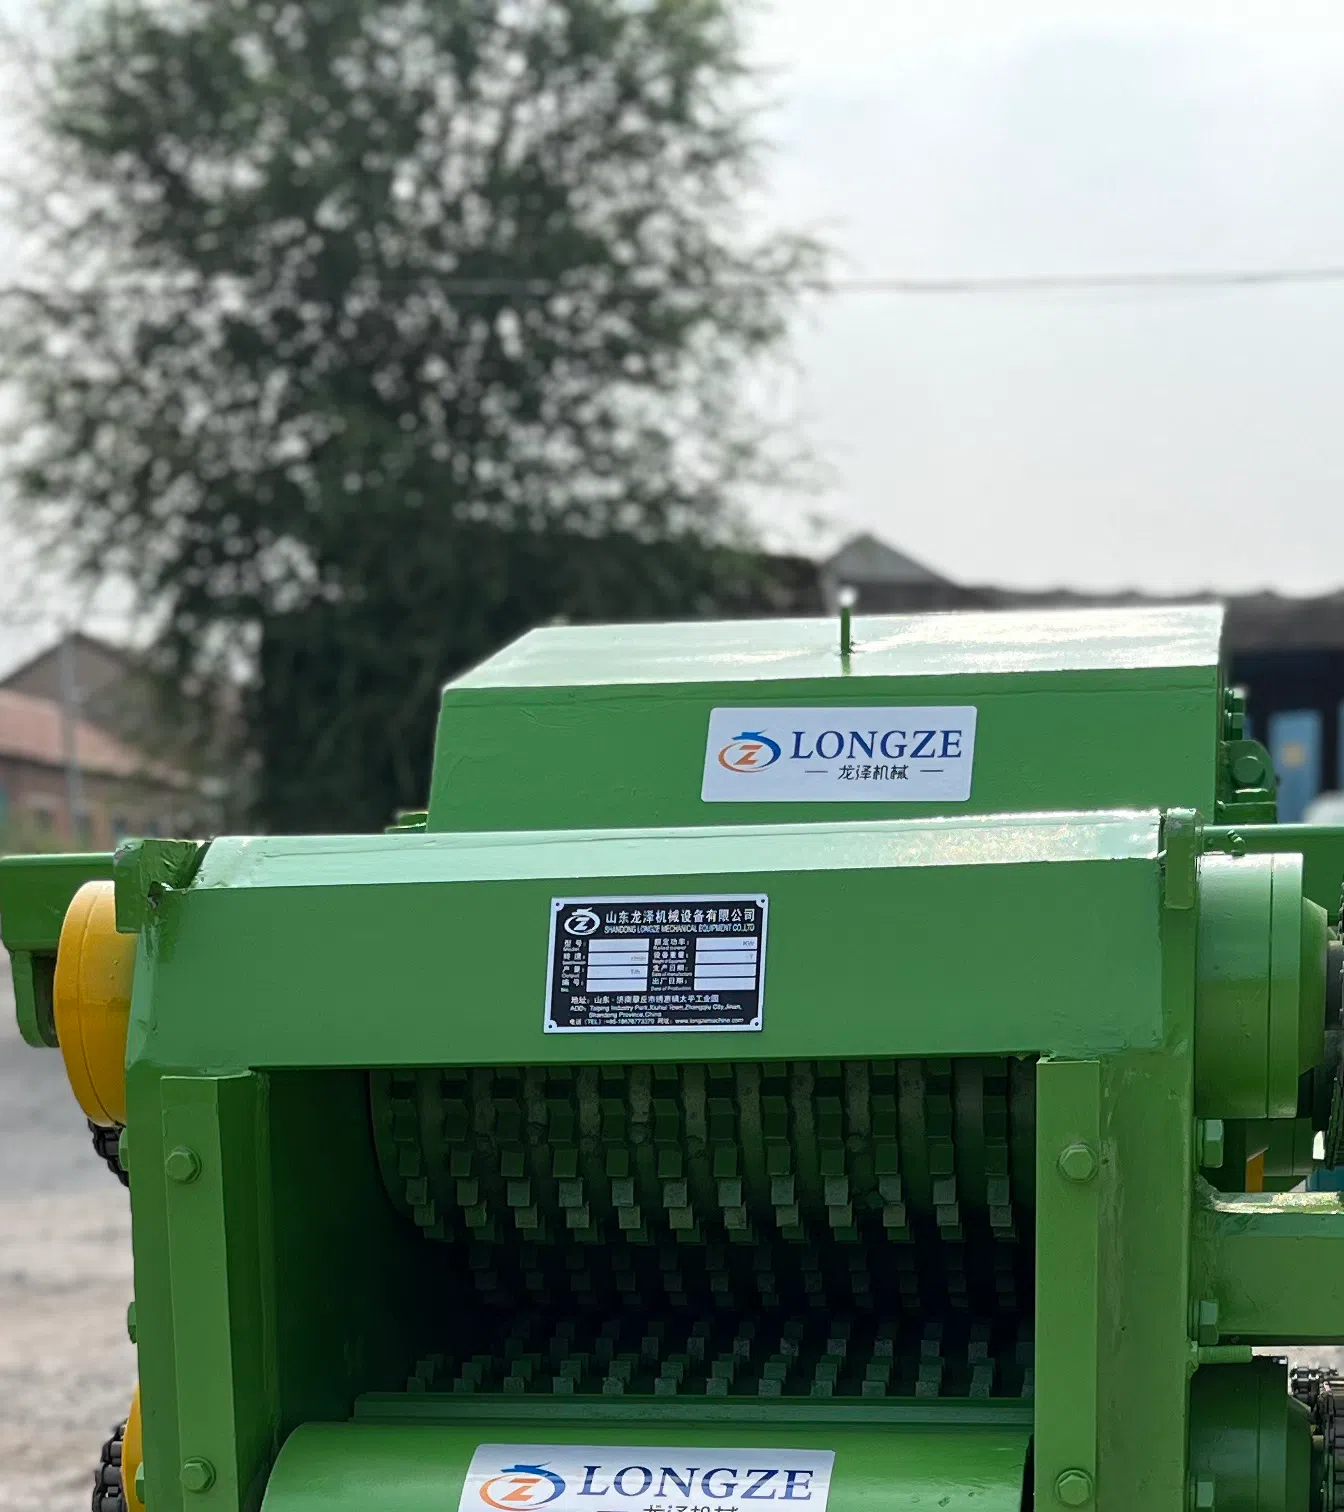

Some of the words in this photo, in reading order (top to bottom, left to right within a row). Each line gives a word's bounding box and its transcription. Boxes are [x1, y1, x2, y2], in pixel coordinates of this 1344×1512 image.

[789, 729, 963, 761] LONGZE
[837, 764, 909, 781] 龙泽机械
[605, 908, 755, 924] 山东龙泽机械设备有限公司
[604, 926, 636, 934] SHANDONG
[661, 925, 697, 933] MECHANICAL
[698, 924, 731, 932] EQUIPMENT
[576, 1464, 814, 1501] LONGZE
